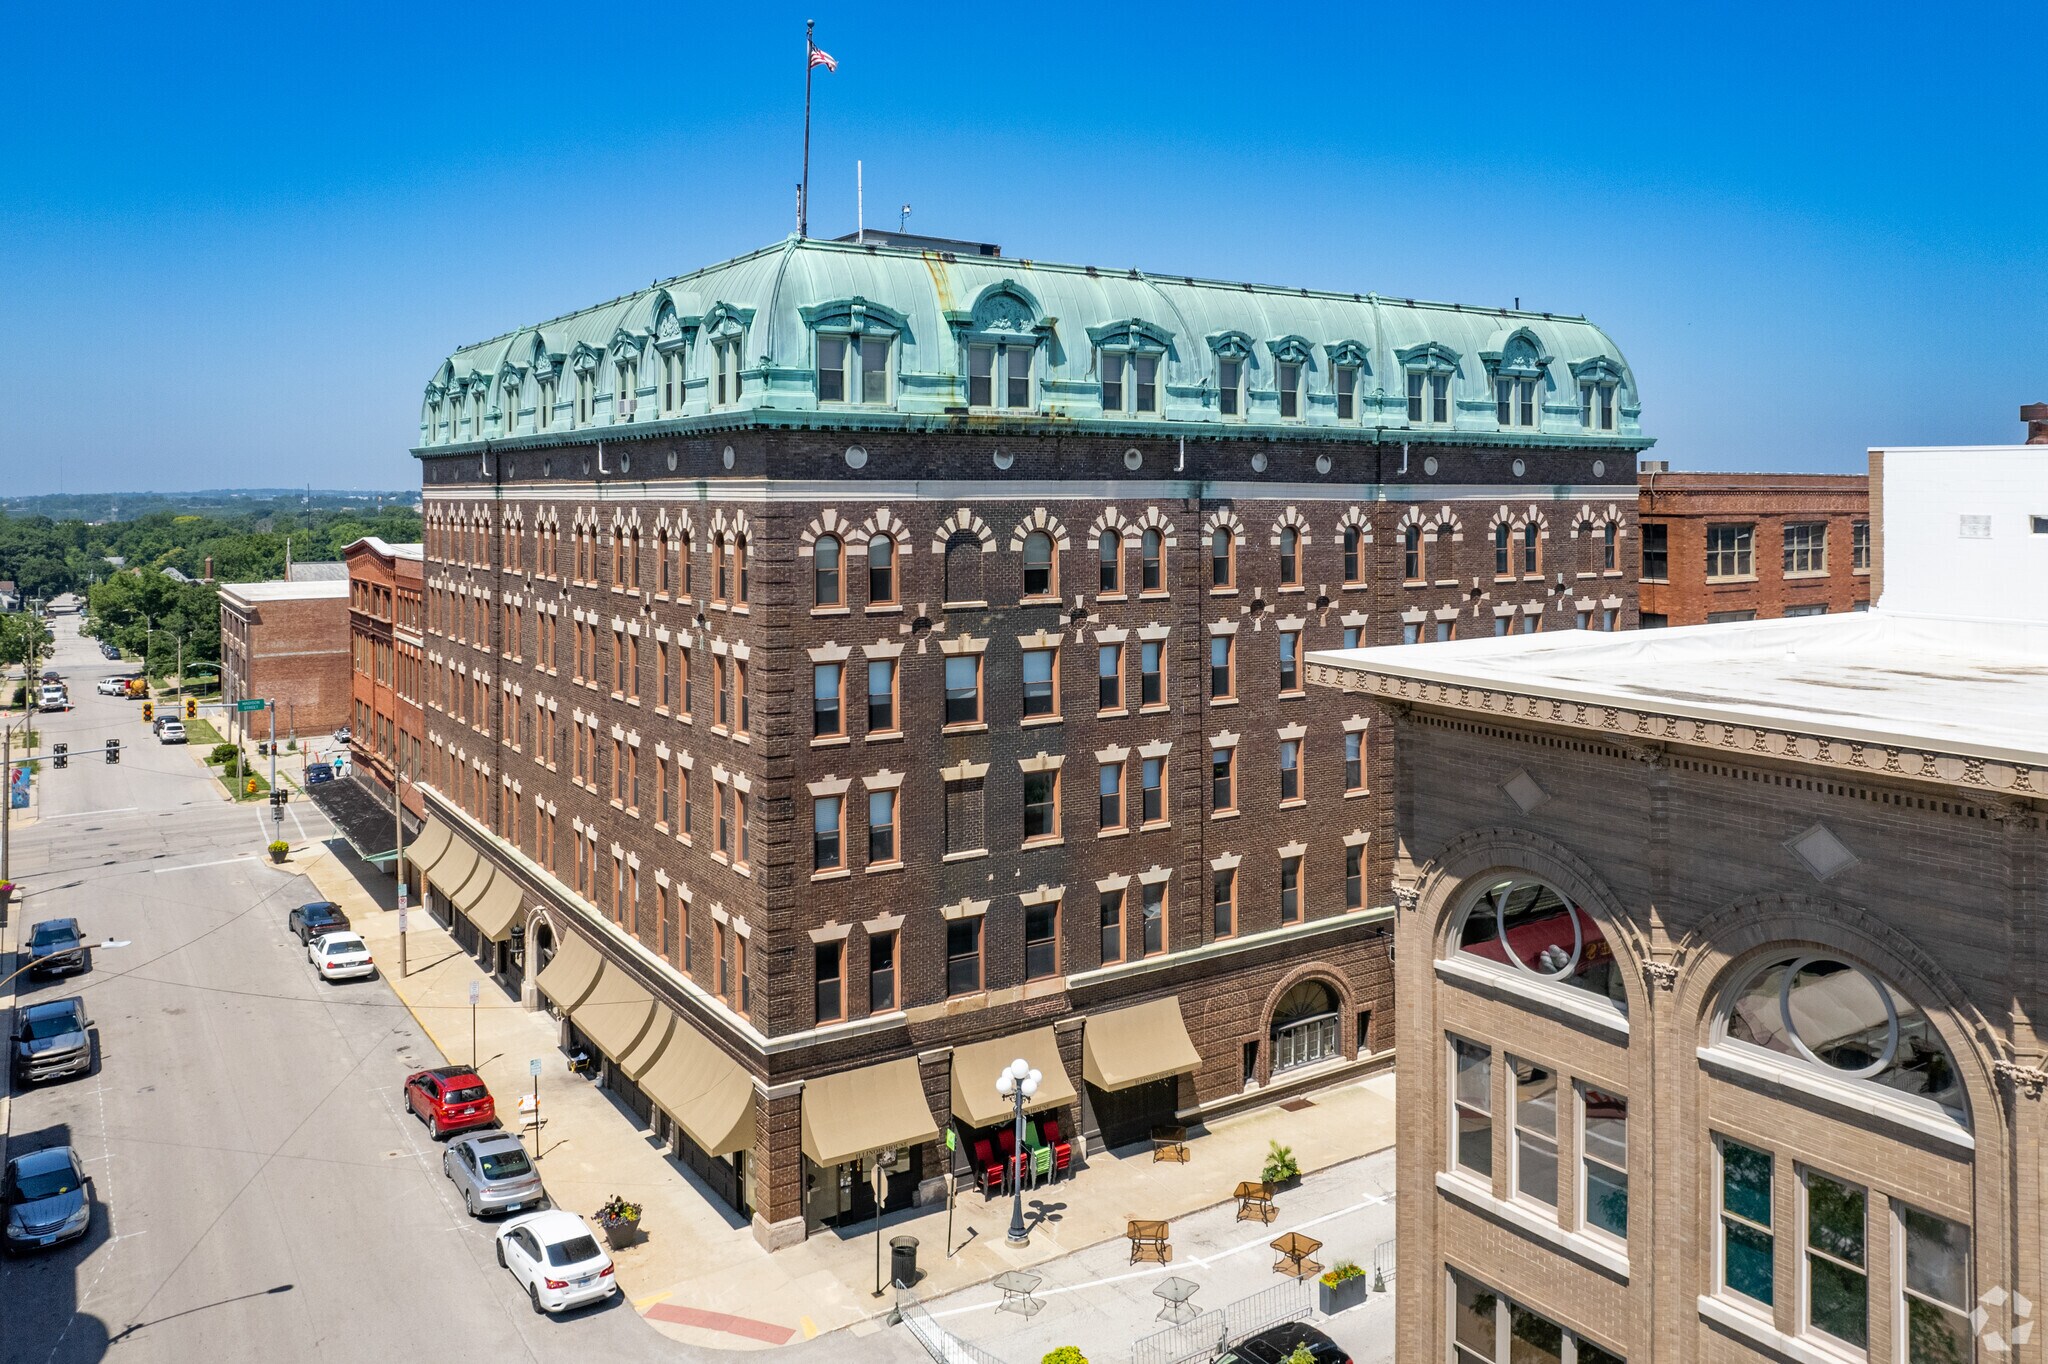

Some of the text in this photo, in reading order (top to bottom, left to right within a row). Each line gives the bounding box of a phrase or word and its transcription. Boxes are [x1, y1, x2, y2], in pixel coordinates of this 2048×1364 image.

[1030, 1104, 1049, 1113] HOUSE
[855, 1142, 907, 1158] ILLINOIS HOUSE
